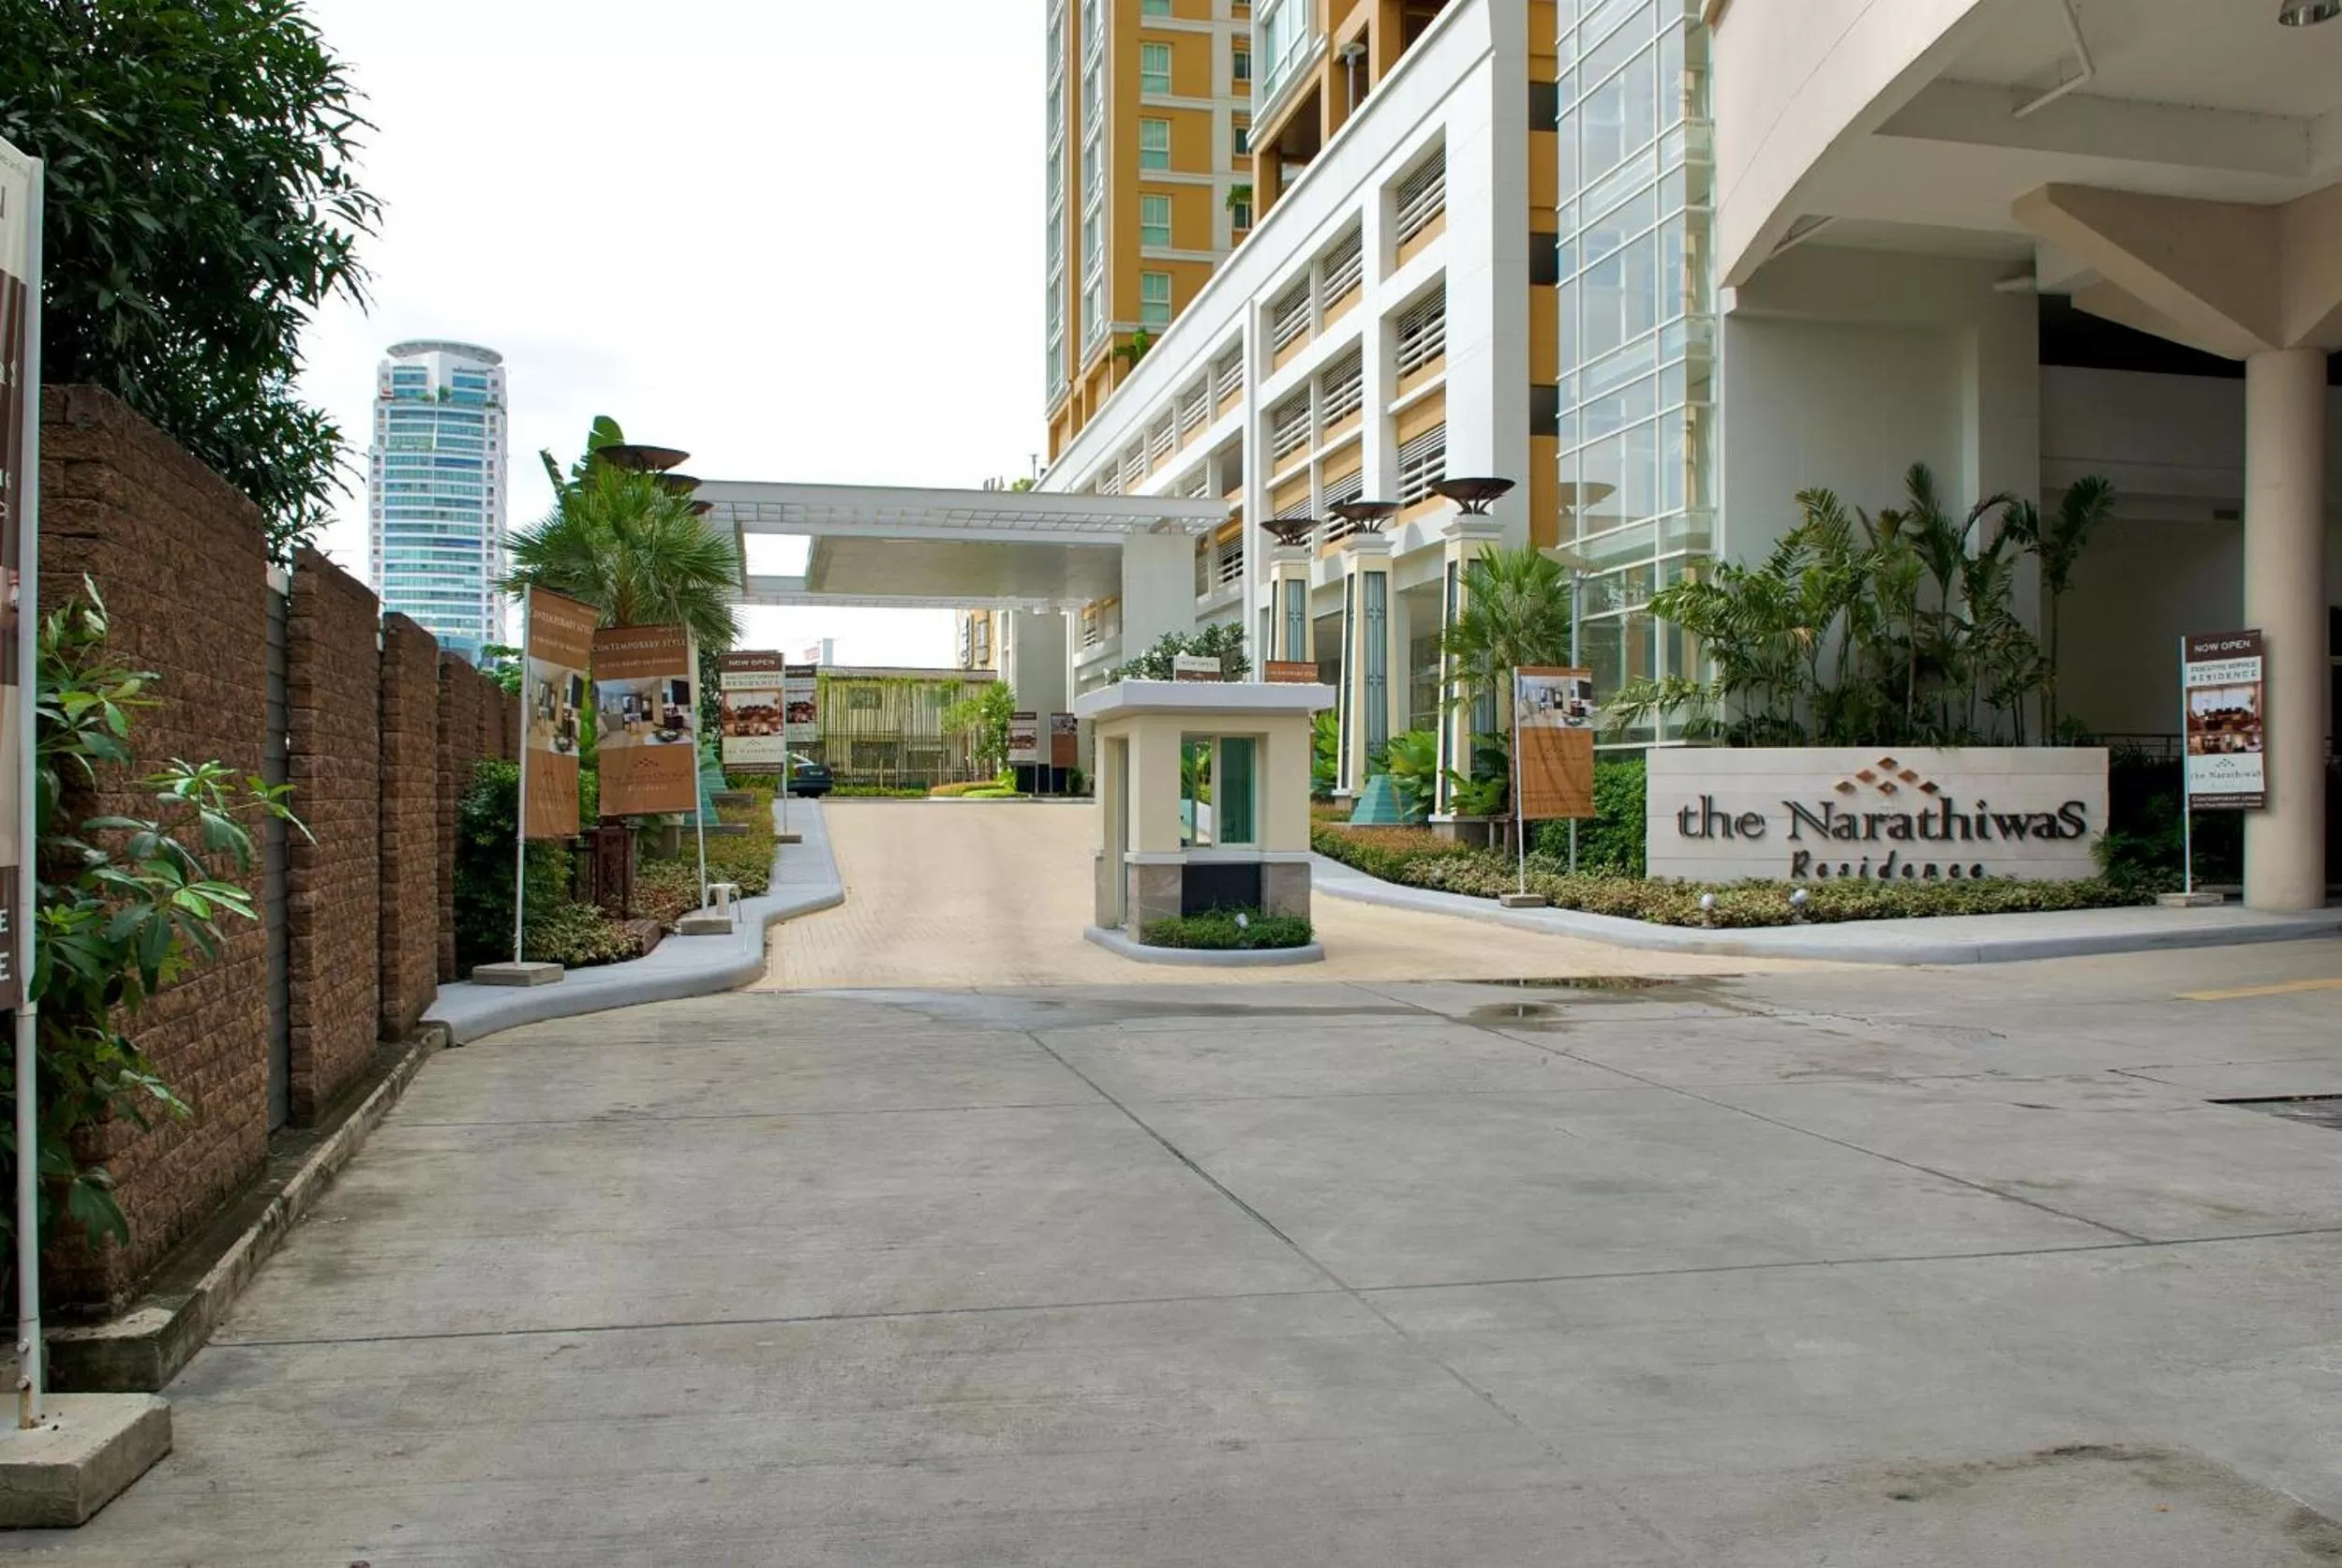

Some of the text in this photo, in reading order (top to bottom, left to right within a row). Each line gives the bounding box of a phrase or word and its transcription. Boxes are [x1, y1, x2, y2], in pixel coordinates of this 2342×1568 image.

[2194, 639, 2251, 652] NOW OPEN
[751, 659, 776, 667] OPEN
[1677, 794, 1766, 841] the
[1790, 849, 1984, 879] Residence
